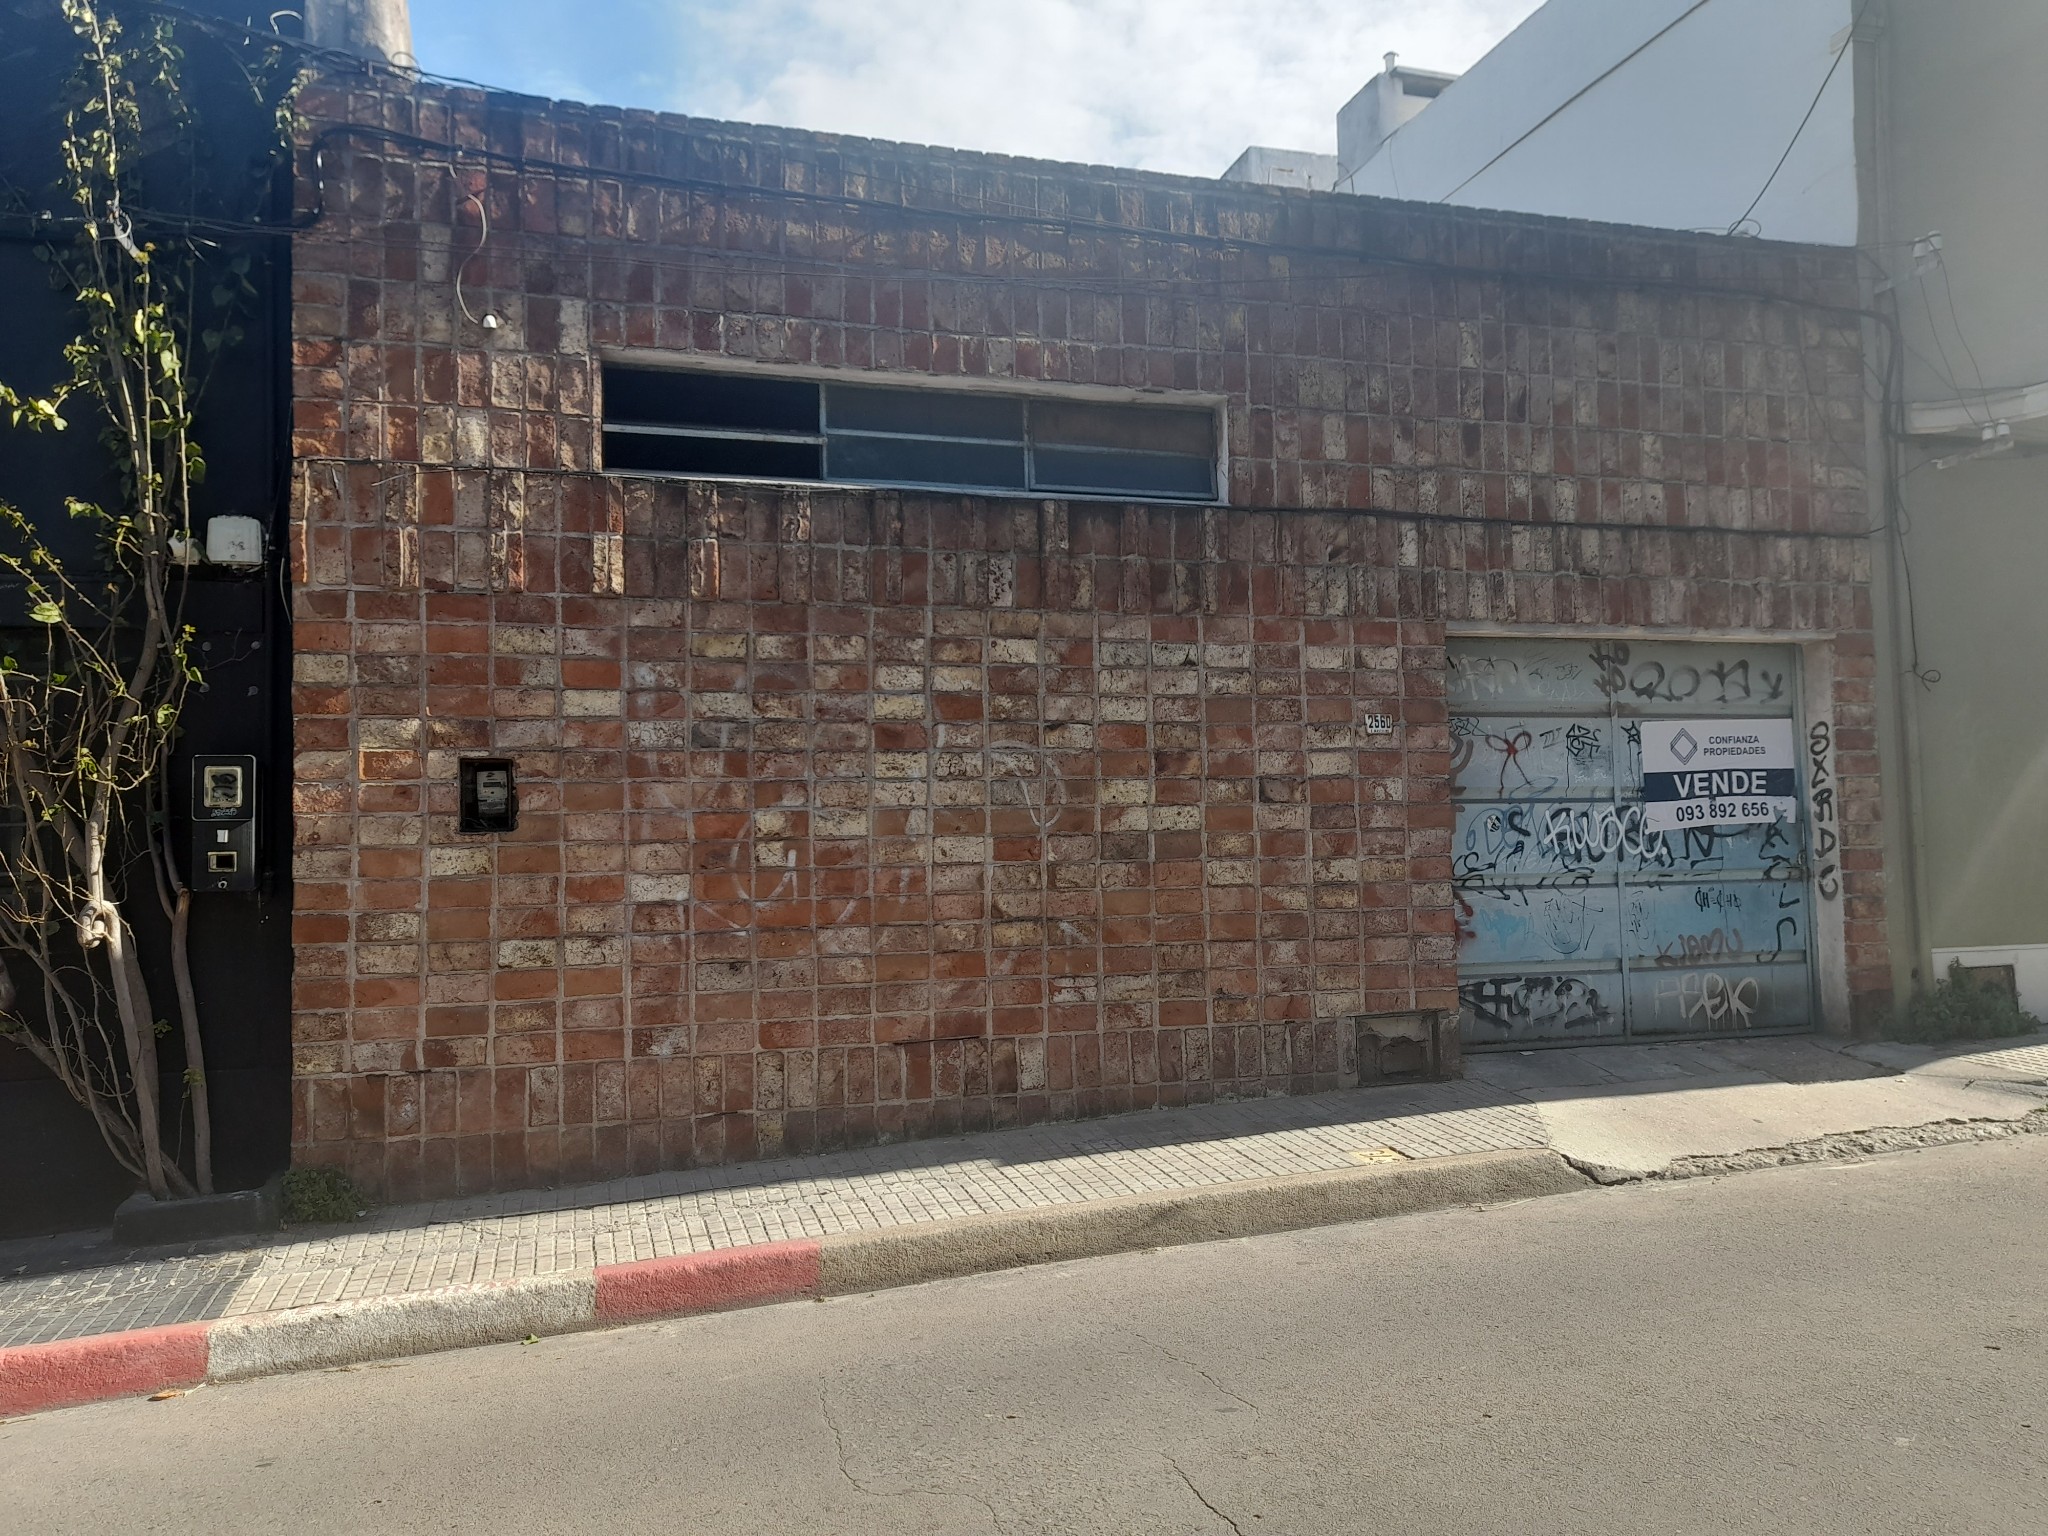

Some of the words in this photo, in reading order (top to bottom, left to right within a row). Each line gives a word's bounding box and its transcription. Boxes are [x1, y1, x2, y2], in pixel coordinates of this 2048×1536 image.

[1367, 714, 1391, 729] 2560
[1708, 735, 1760, 745] CONFIANZA
[1703, 746, 1766, 756] PROPIEDADES
[1672, 770, 1768, 798] VENDE
[1676, 804, 1705, 822] 093
[1709, 802, 1736, 819] 892
[1741, 801, 1769, 817] 656
